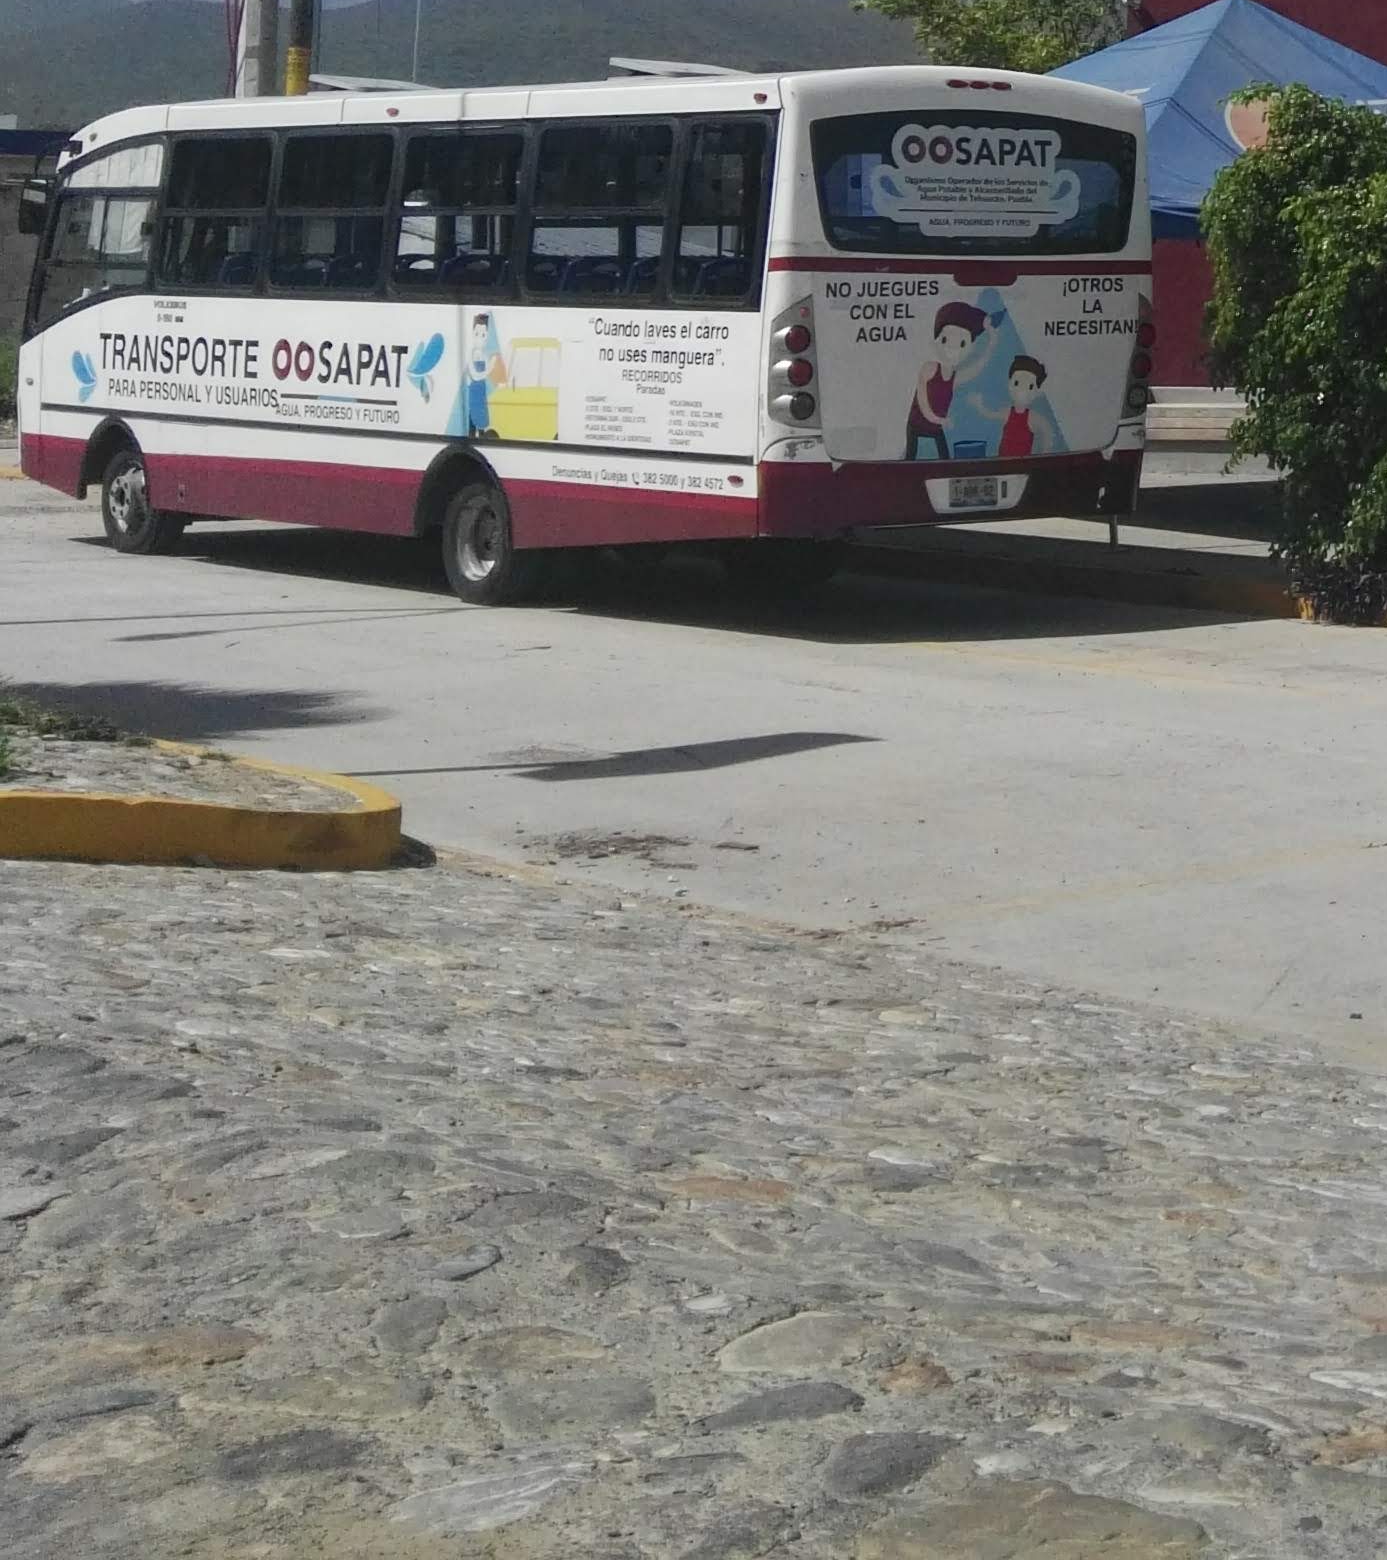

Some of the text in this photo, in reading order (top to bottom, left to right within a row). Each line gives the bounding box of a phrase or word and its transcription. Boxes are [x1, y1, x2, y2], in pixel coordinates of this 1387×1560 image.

[901, 135, 1052, 167] OOSAPAT
[825, 281, 939, 298] NO JUEGUES
[1063, 277, 1124, 296] ¡OTROS
[850, 303, 915, 320] CON EL
[1082, 299, 1103, 314] LA
[643, 320, 677, 339] laves
[680, 321, 692, 339] el
[695, 325, 729, 340] carro
[855, 326, 907, 342] AGUA
[1044, 320, 1139, 336] NECESITAN!
[100, 332, 408, 388] TRANSPORTE OOSAPAT
[599, 347, 614, 362] no
[618, 348, 647, 363] uses
[622, 369, 682, 383] RECORRIDOS
[108, 378, 137, 399] PARA
[140, 380, 201, 403] PERSONAL
[205, 385, 213, 403] Y
[304, 405, 353, 420] PROGRESO
[354, 408, 361, 421] Y
[363, 409, 400, 424] FUTURO
[552, 465, 592, 479] Denuncias
[594, 471, 599, 483] y
[601, 468, 628, 484] Quejas
[642, 472, 657, 484] 382
[680, 477, 685, 489] y
[704, 477, 723, 490] 4572
